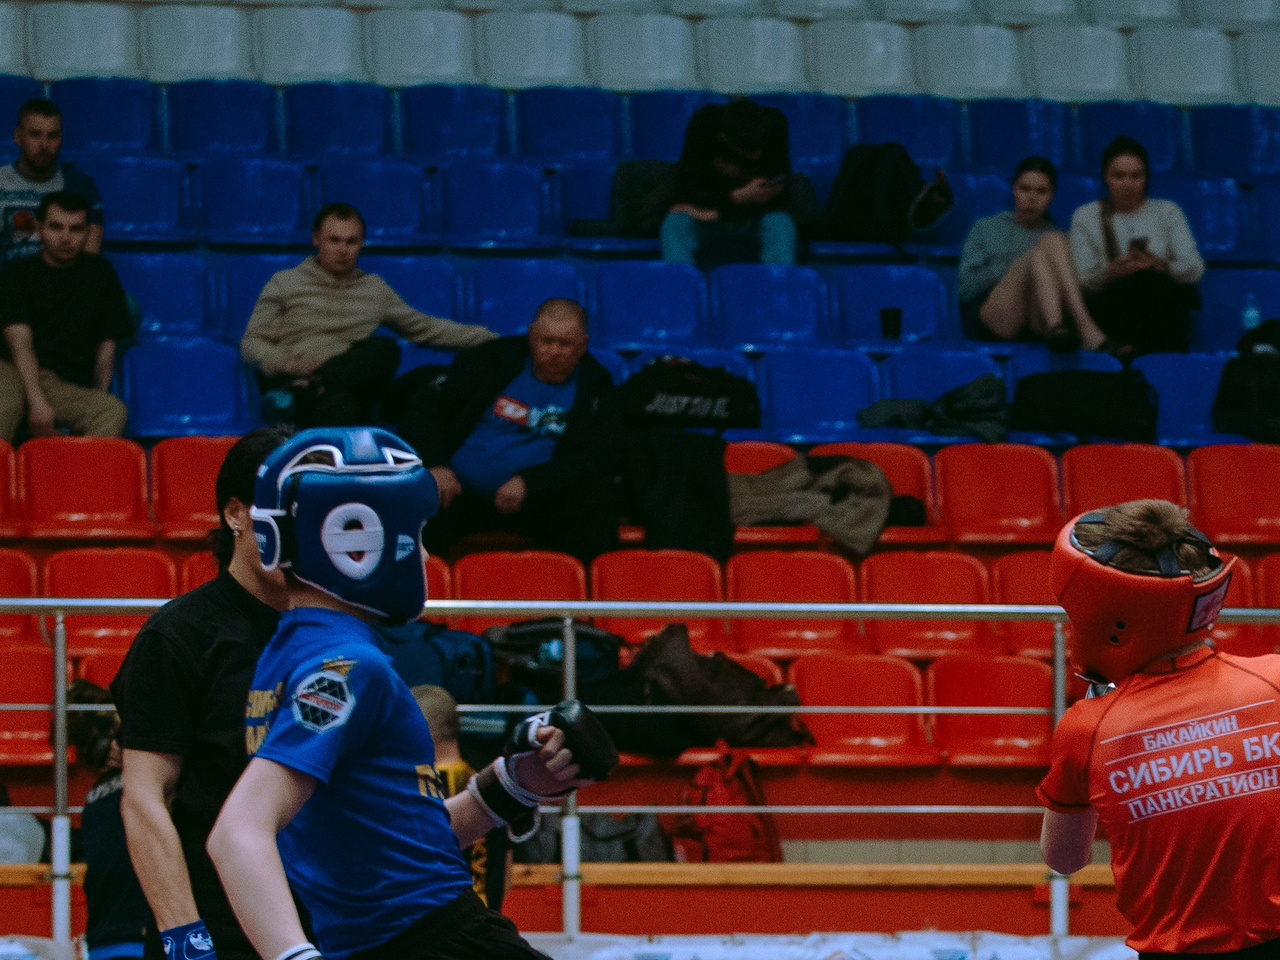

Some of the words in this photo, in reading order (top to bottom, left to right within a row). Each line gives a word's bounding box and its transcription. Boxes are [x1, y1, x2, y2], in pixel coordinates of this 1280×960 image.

[1142, 715, 1238, 751] БАКАЙКИН
[1109, 745, 1233, 794] СИБИРЬ
[1128, 769, 1278, 820] ПАНКРАТИОН
